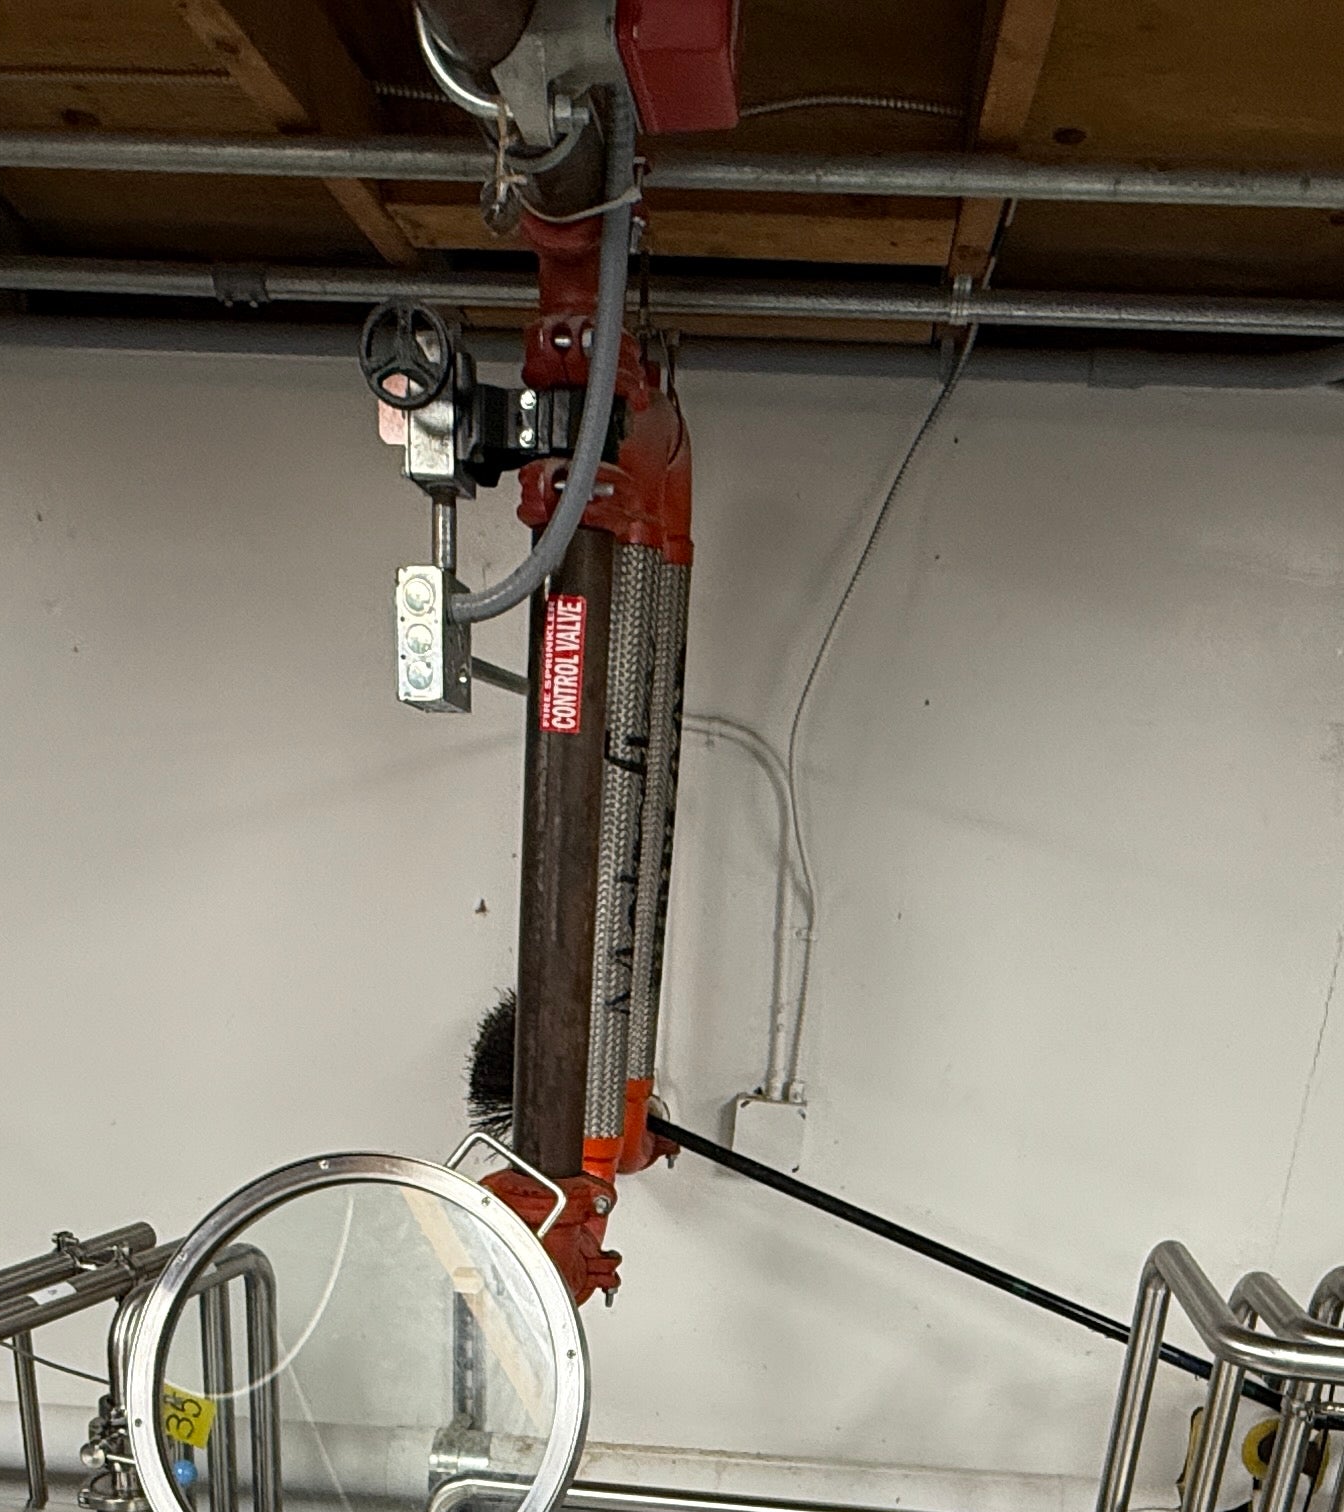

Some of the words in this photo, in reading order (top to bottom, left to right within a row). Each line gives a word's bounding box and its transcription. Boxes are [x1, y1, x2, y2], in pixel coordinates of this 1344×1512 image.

[545, 601, 555, 689] SPRINKLER
[555, 600, 582, 651] VALVE
[542, 694, 552, 728] FIRE
[552, 655, 579, 729] CONTROL
